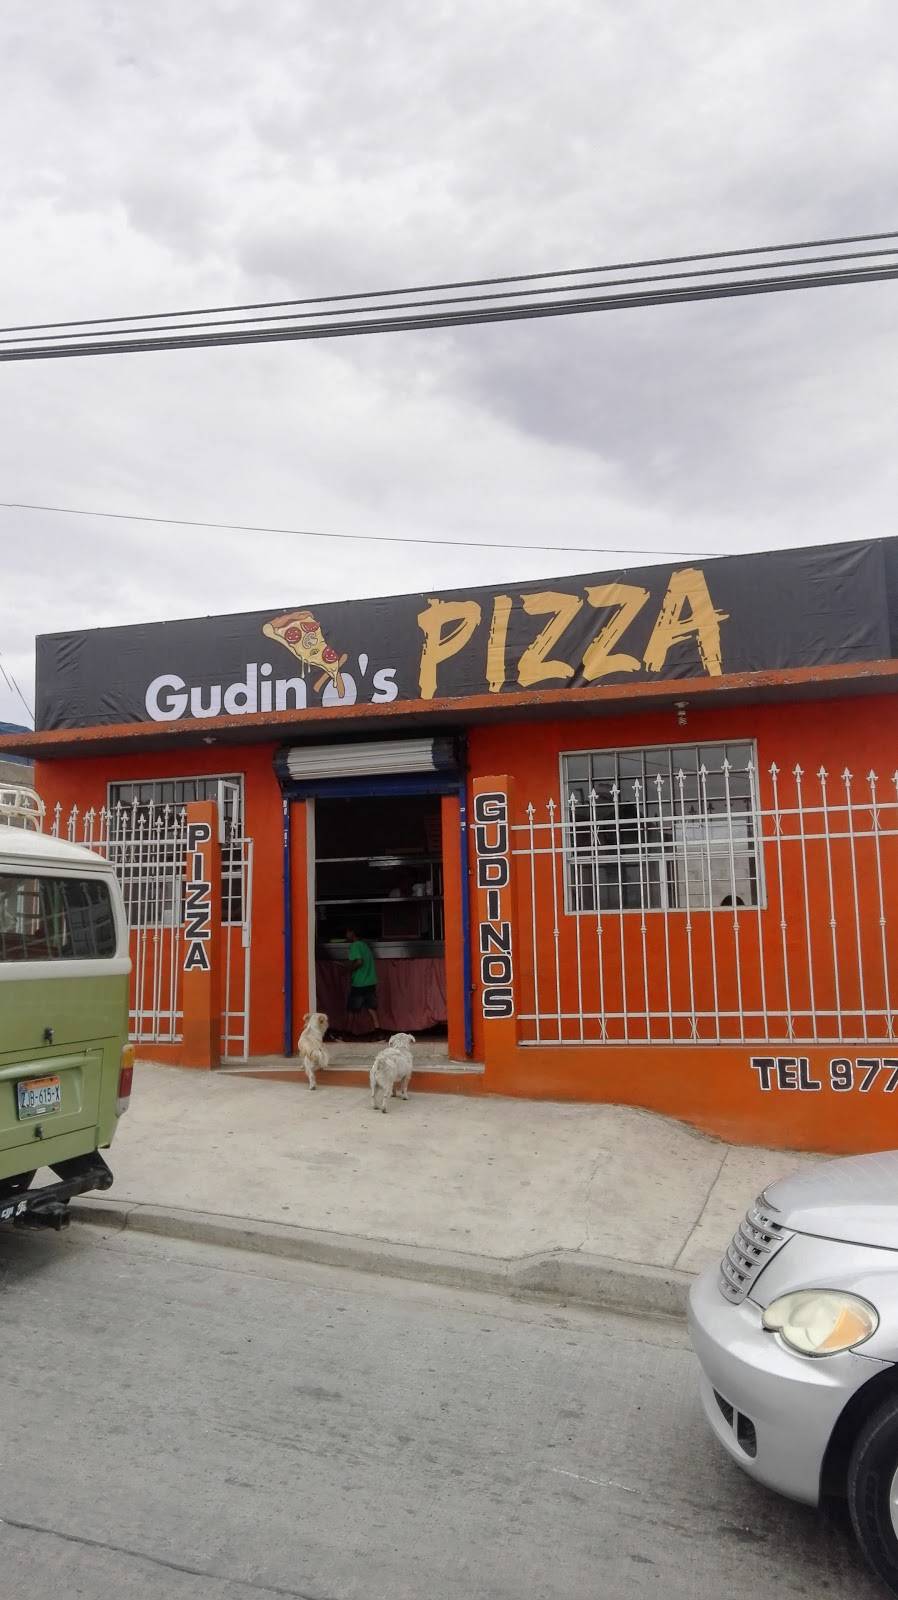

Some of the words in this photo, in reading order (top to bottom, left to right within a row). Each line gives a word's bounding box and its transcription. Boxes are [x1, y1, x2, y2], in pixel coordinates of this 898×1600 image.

[145, 653, 399, 721] Gudino's
[417, 568, 730, 699] PIZZA
[184, 823, 211, 971] PIZZA
[750, 1057, 822, 1091] TEL
[830, 1058, 898, 1092] 977
